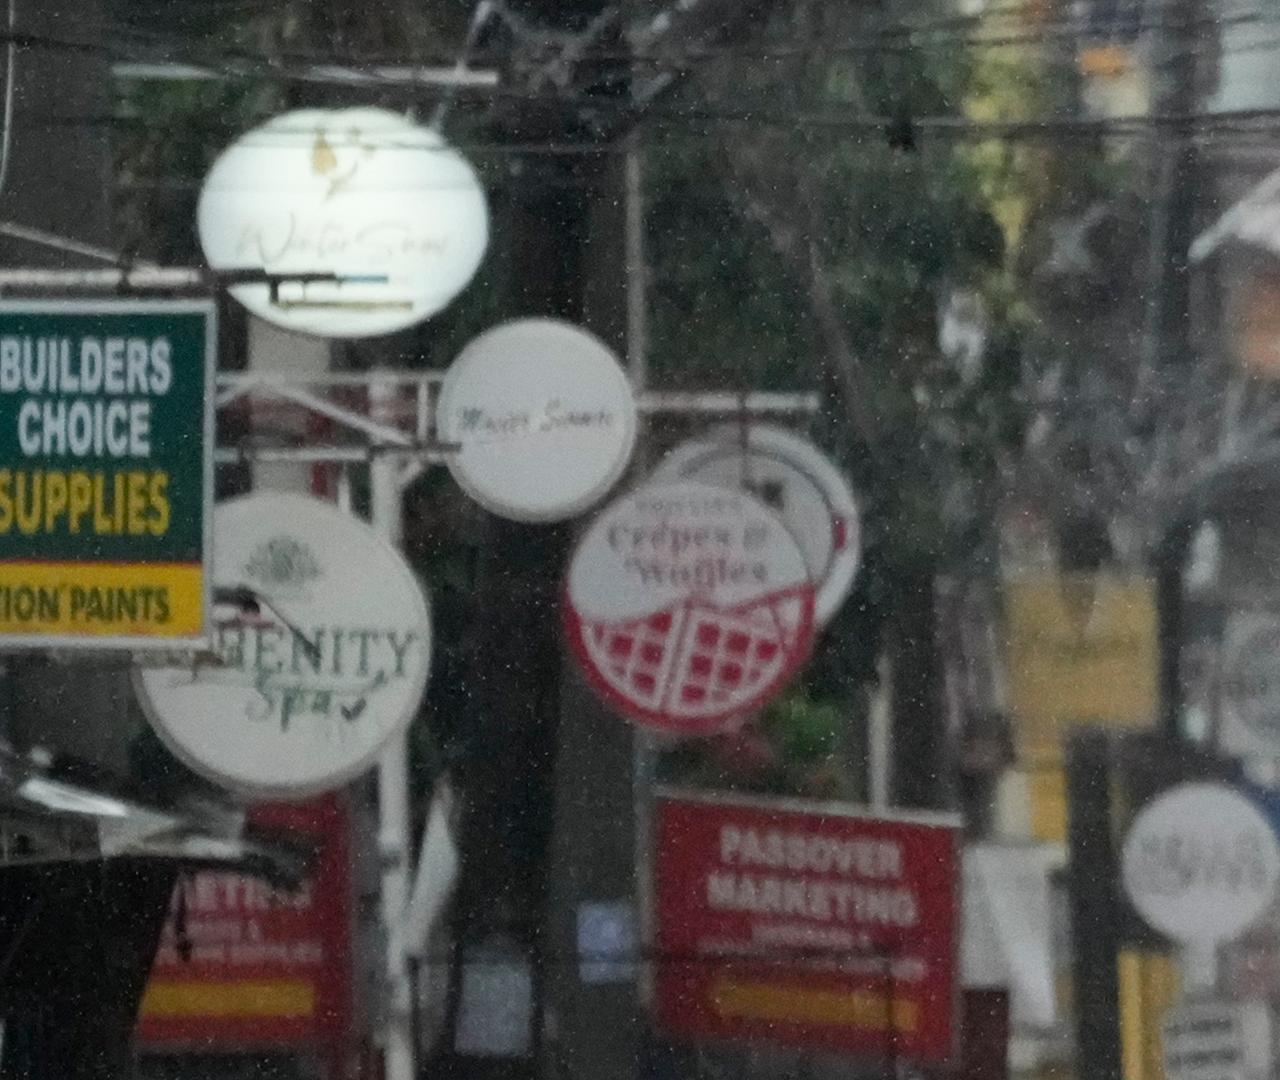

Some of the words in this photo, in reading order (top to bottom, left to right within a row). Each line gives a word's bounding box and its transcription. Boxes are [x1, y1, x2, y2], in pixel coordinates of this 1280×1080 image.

[0, 336, 172, 395] BUILDERS
[18, 400, 152, 457] CHOICE
[0, 469, 171, 536] SUPPLIES
[0, 586, 59, 622] ION
[70, 586, 171, 626] PAINTS
[245, 666, 334, 732] Spa
[719, 823, 903, 880] PASSOVER
[706, 869, 918, 928] MARKETING
